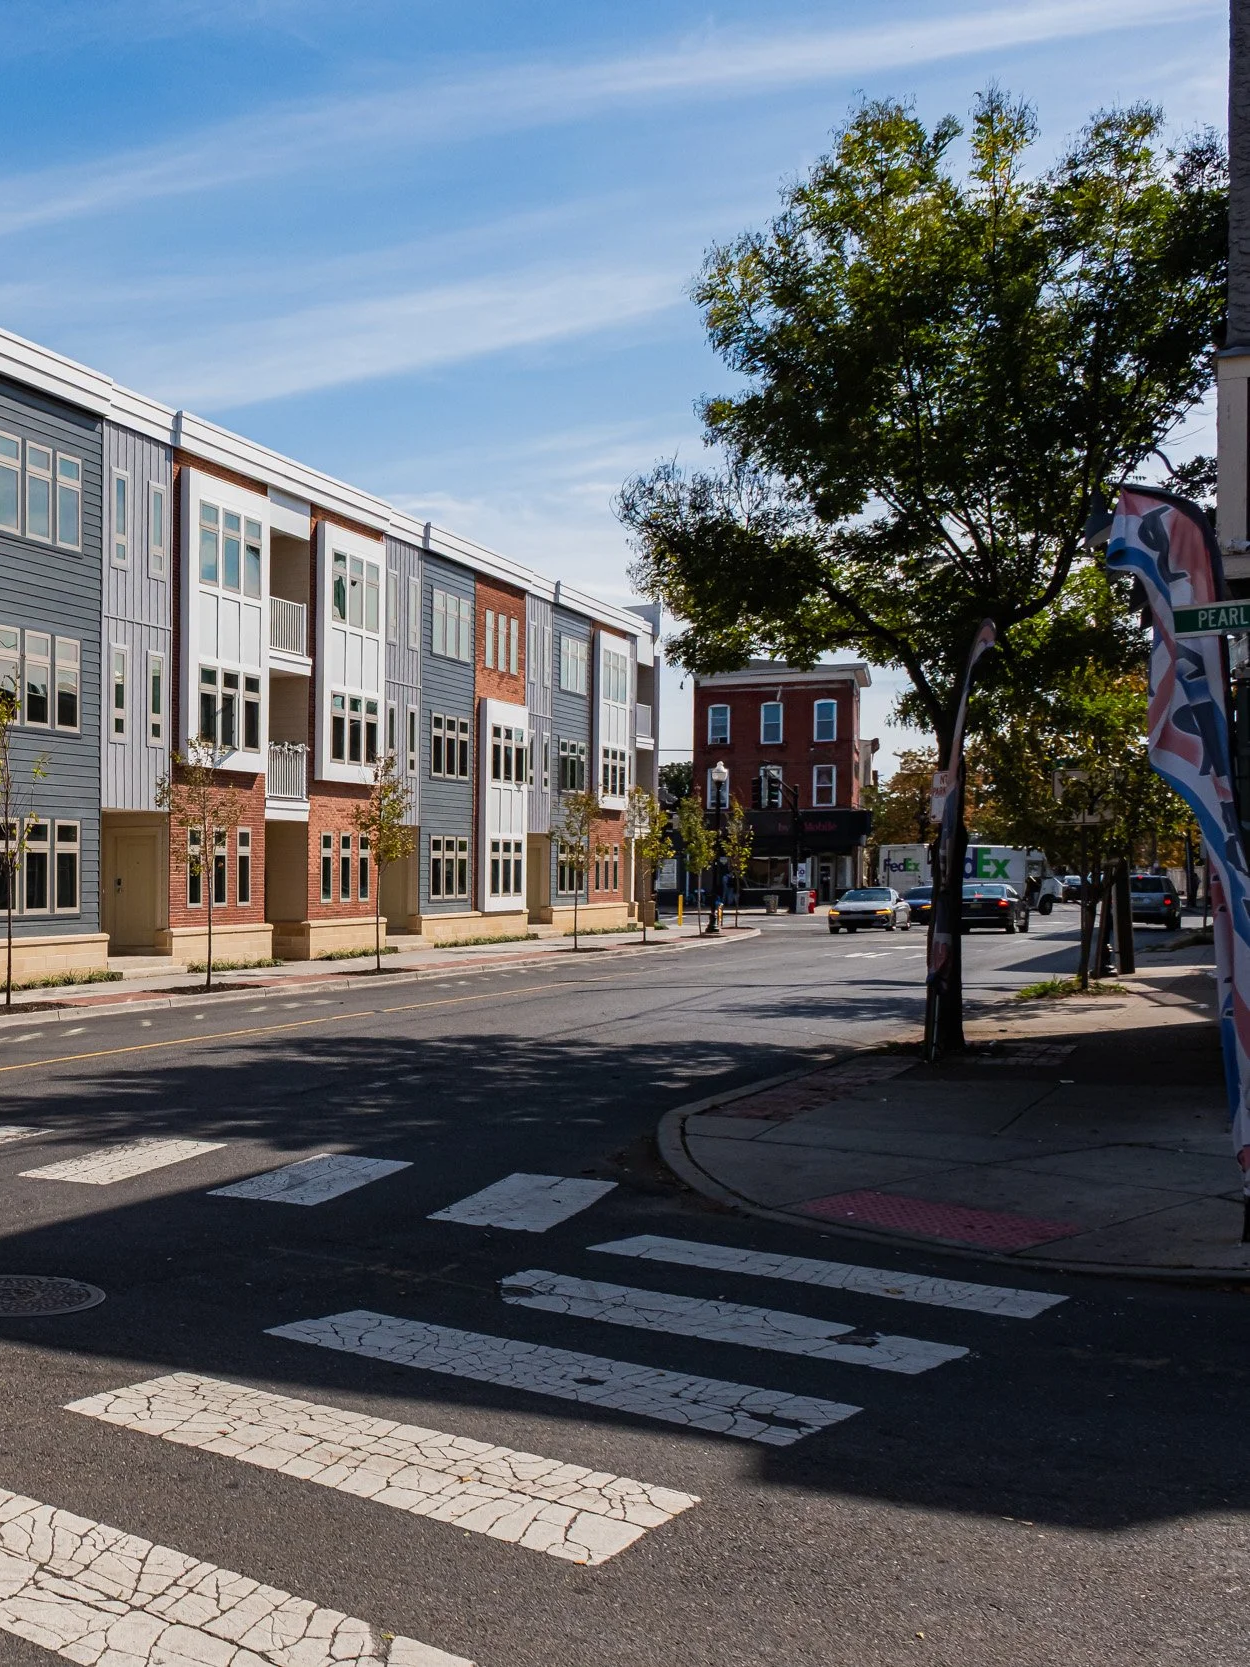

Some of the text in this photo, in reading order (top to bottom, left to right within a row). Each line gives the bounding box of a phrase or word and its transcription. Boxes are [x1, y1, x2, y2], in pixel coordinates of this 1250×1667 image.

[1198, 607, 1249, 628] PEARL
[803, 821, 838, 832] Mobile
[883, 857, 920, 872] FedEx
[963, 848, 1010, 879] dEx
